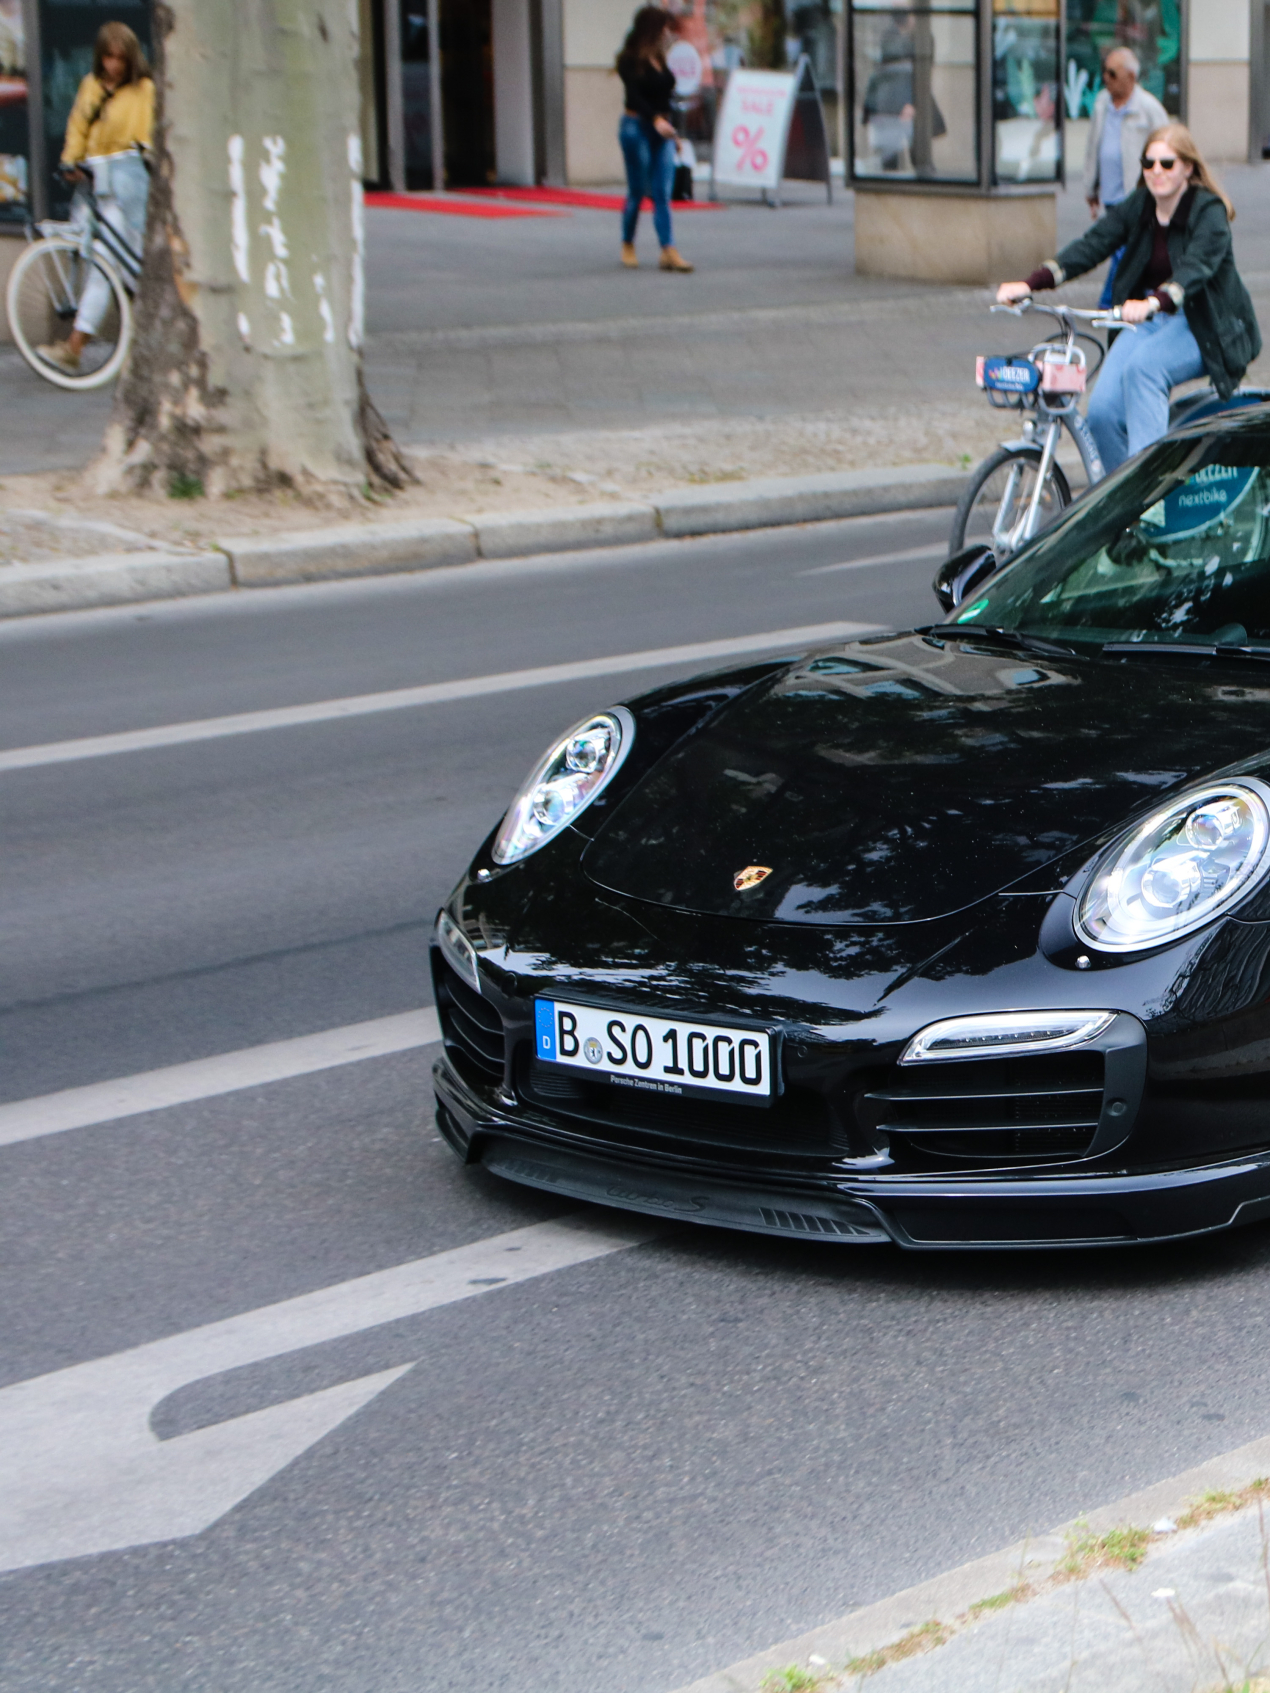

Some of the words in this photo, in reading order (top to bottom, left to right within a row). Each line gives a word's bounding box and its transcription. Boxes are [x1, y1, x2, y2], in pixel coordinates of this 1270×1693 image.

[1002, 366, 1030, 384] DEEZER
[1178, 487, 1227, 507] nextbike
[542, 1035, 551, 1049] D
[558, 1010, 580, 1057] B
[610, 1074, 634, 1086] Porsche
[664, 1083, 683, 1094] Berlin
